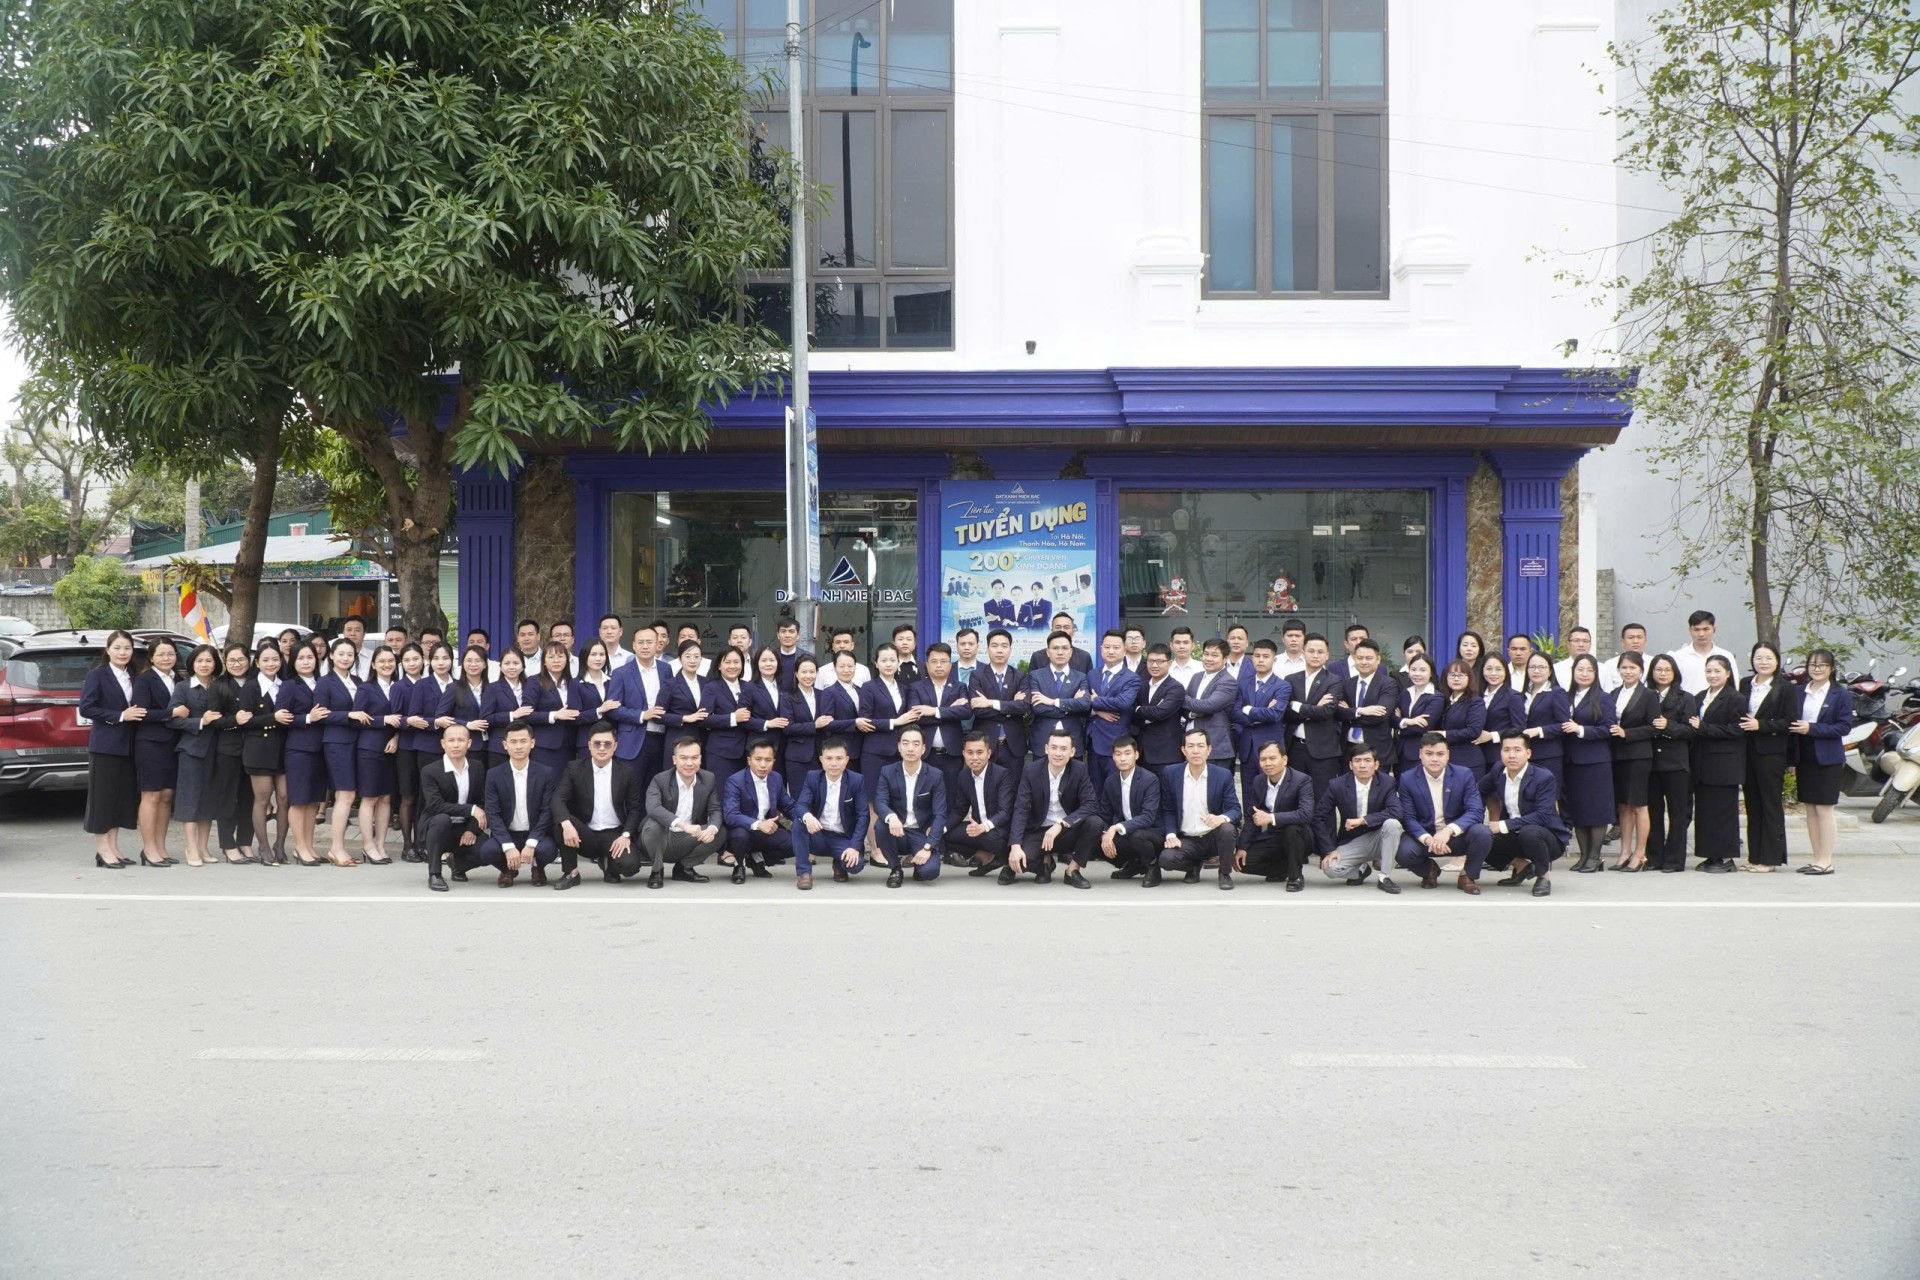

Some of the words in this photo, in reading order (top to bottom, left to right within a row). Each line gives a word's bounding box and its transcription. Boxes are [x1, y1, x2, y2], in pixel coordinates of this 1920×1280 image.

[955, 507, 1023, 546] TUYỂN
[1030, 501, 1087, 532] DỤNG
[884, 590, 913, 602] BAC
